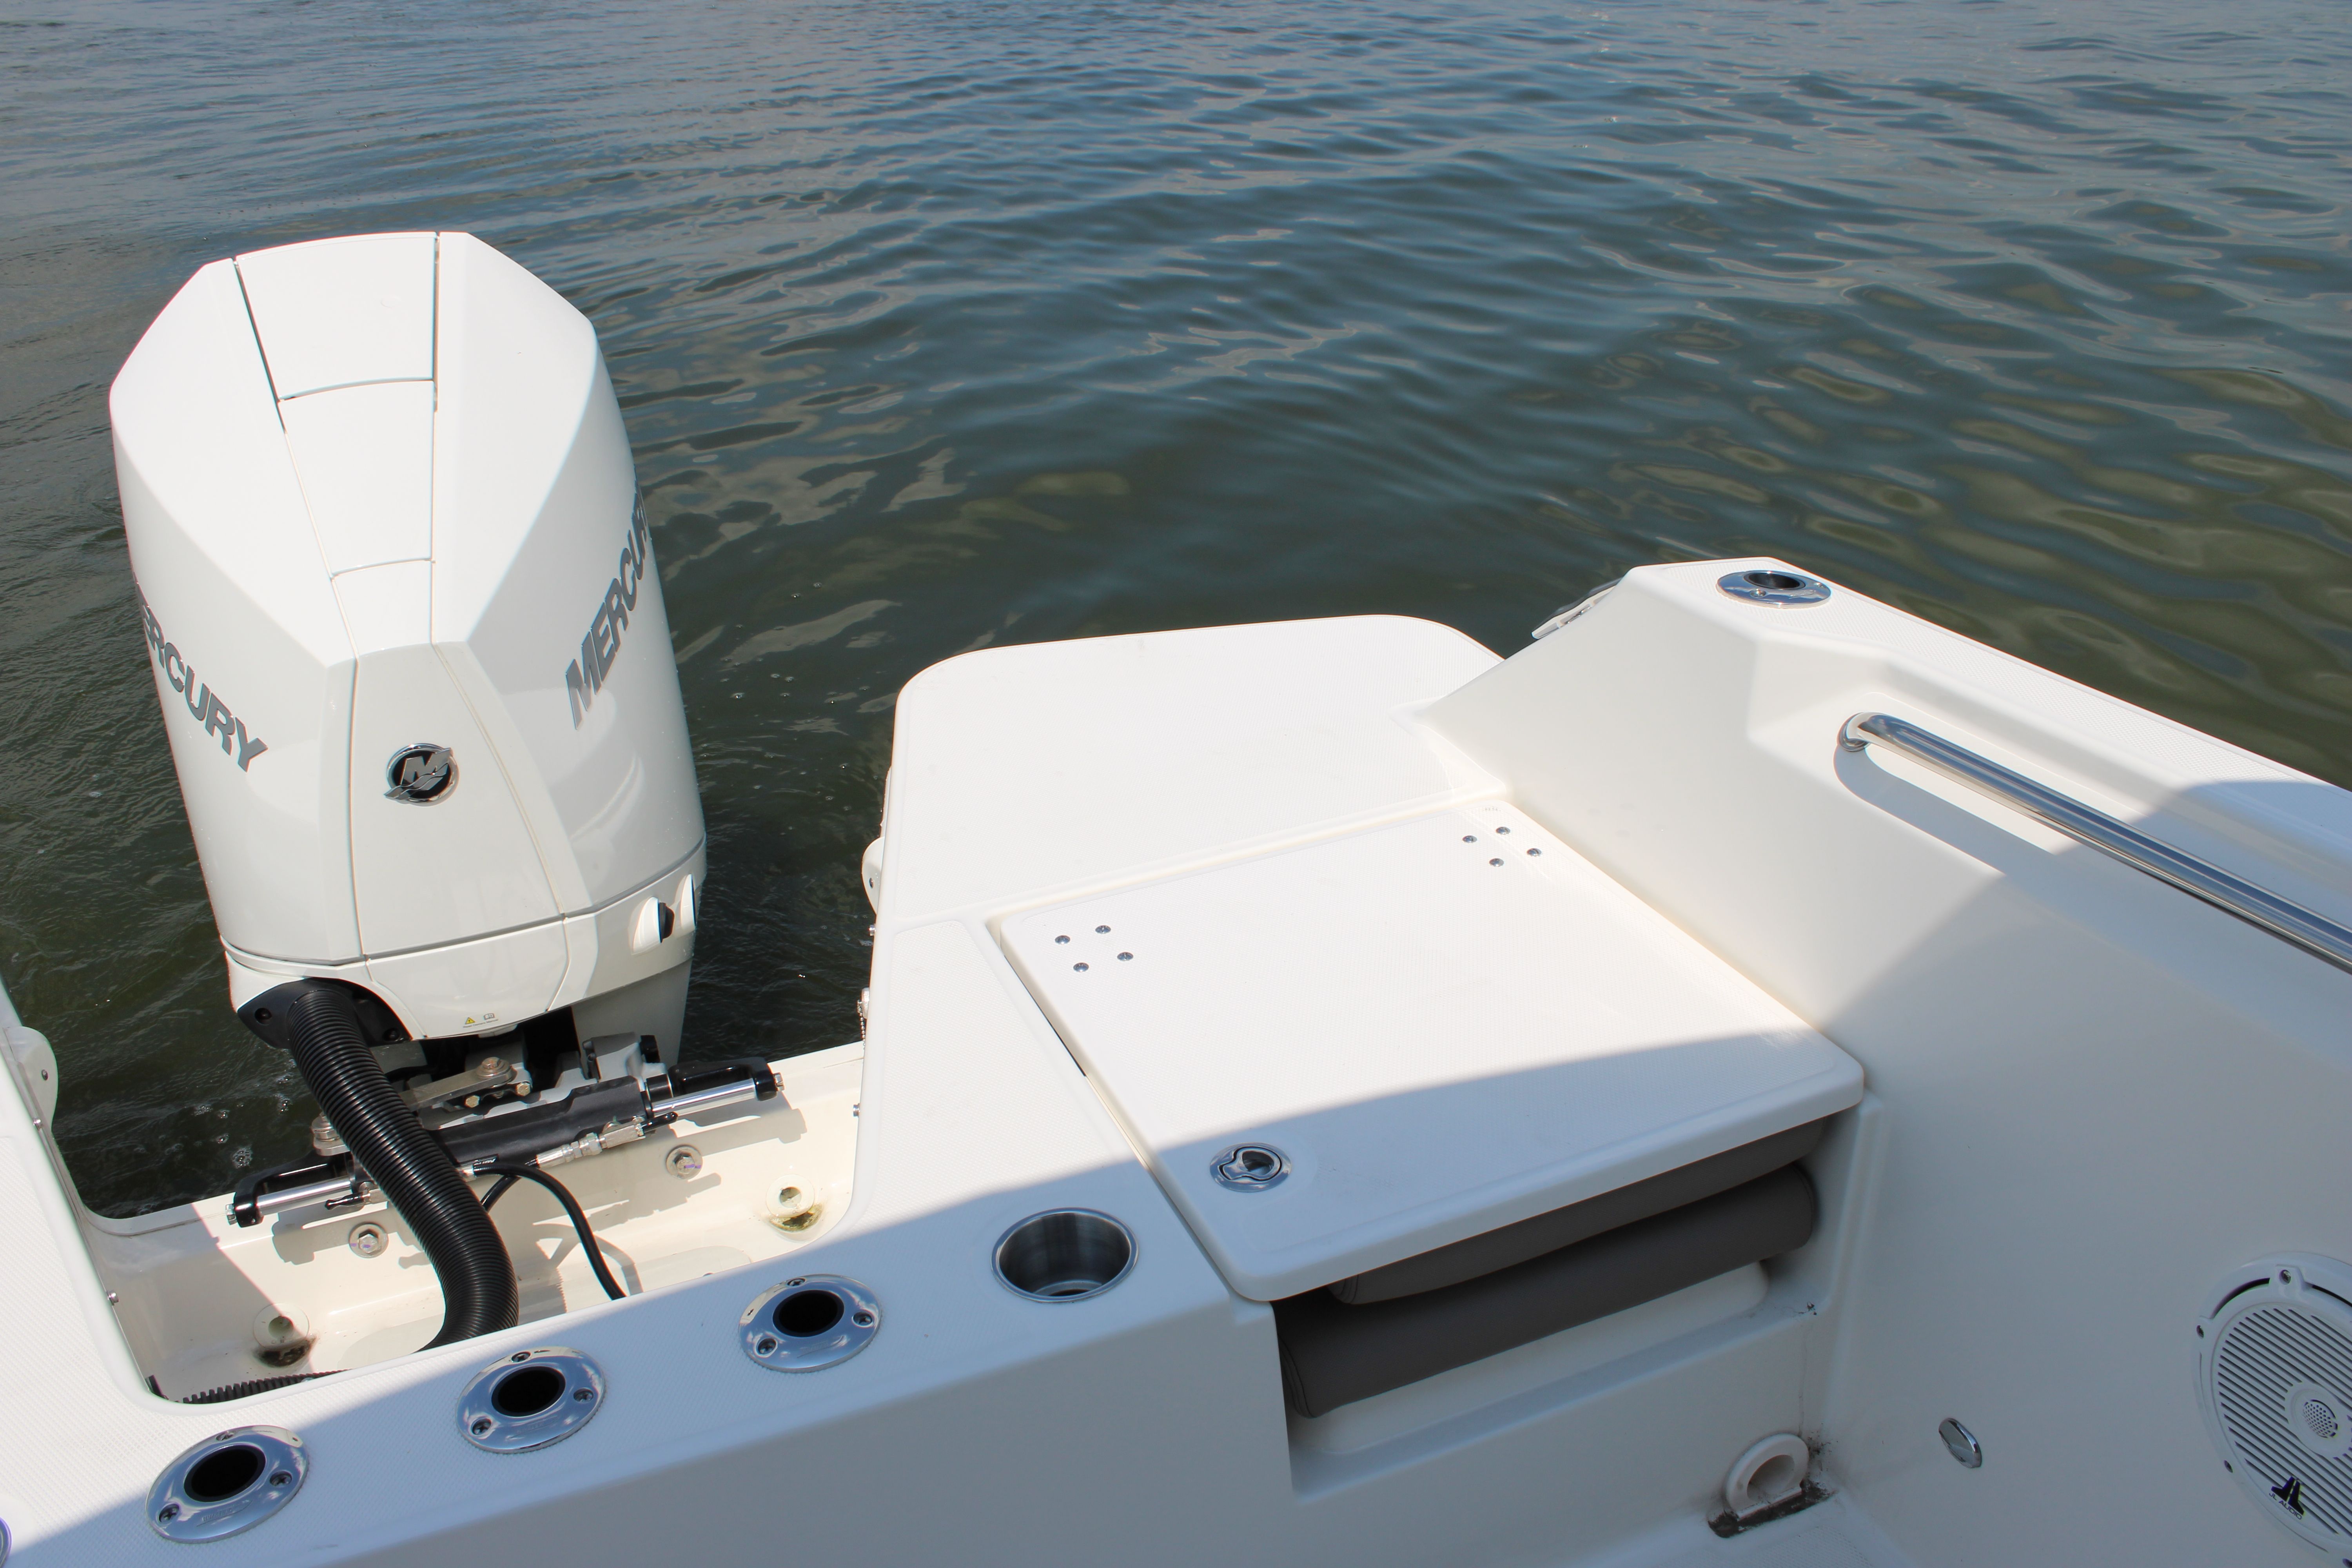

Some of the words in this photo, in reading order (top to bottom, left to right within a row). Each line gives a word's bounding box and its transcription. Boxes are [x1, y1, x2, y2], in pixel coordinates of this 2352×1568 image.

[133, 572, 269, 773] ERCURY
[2269, 1492, 2277, 1501] JL
[2279, 1500, 2302, 1520] AUDIO
